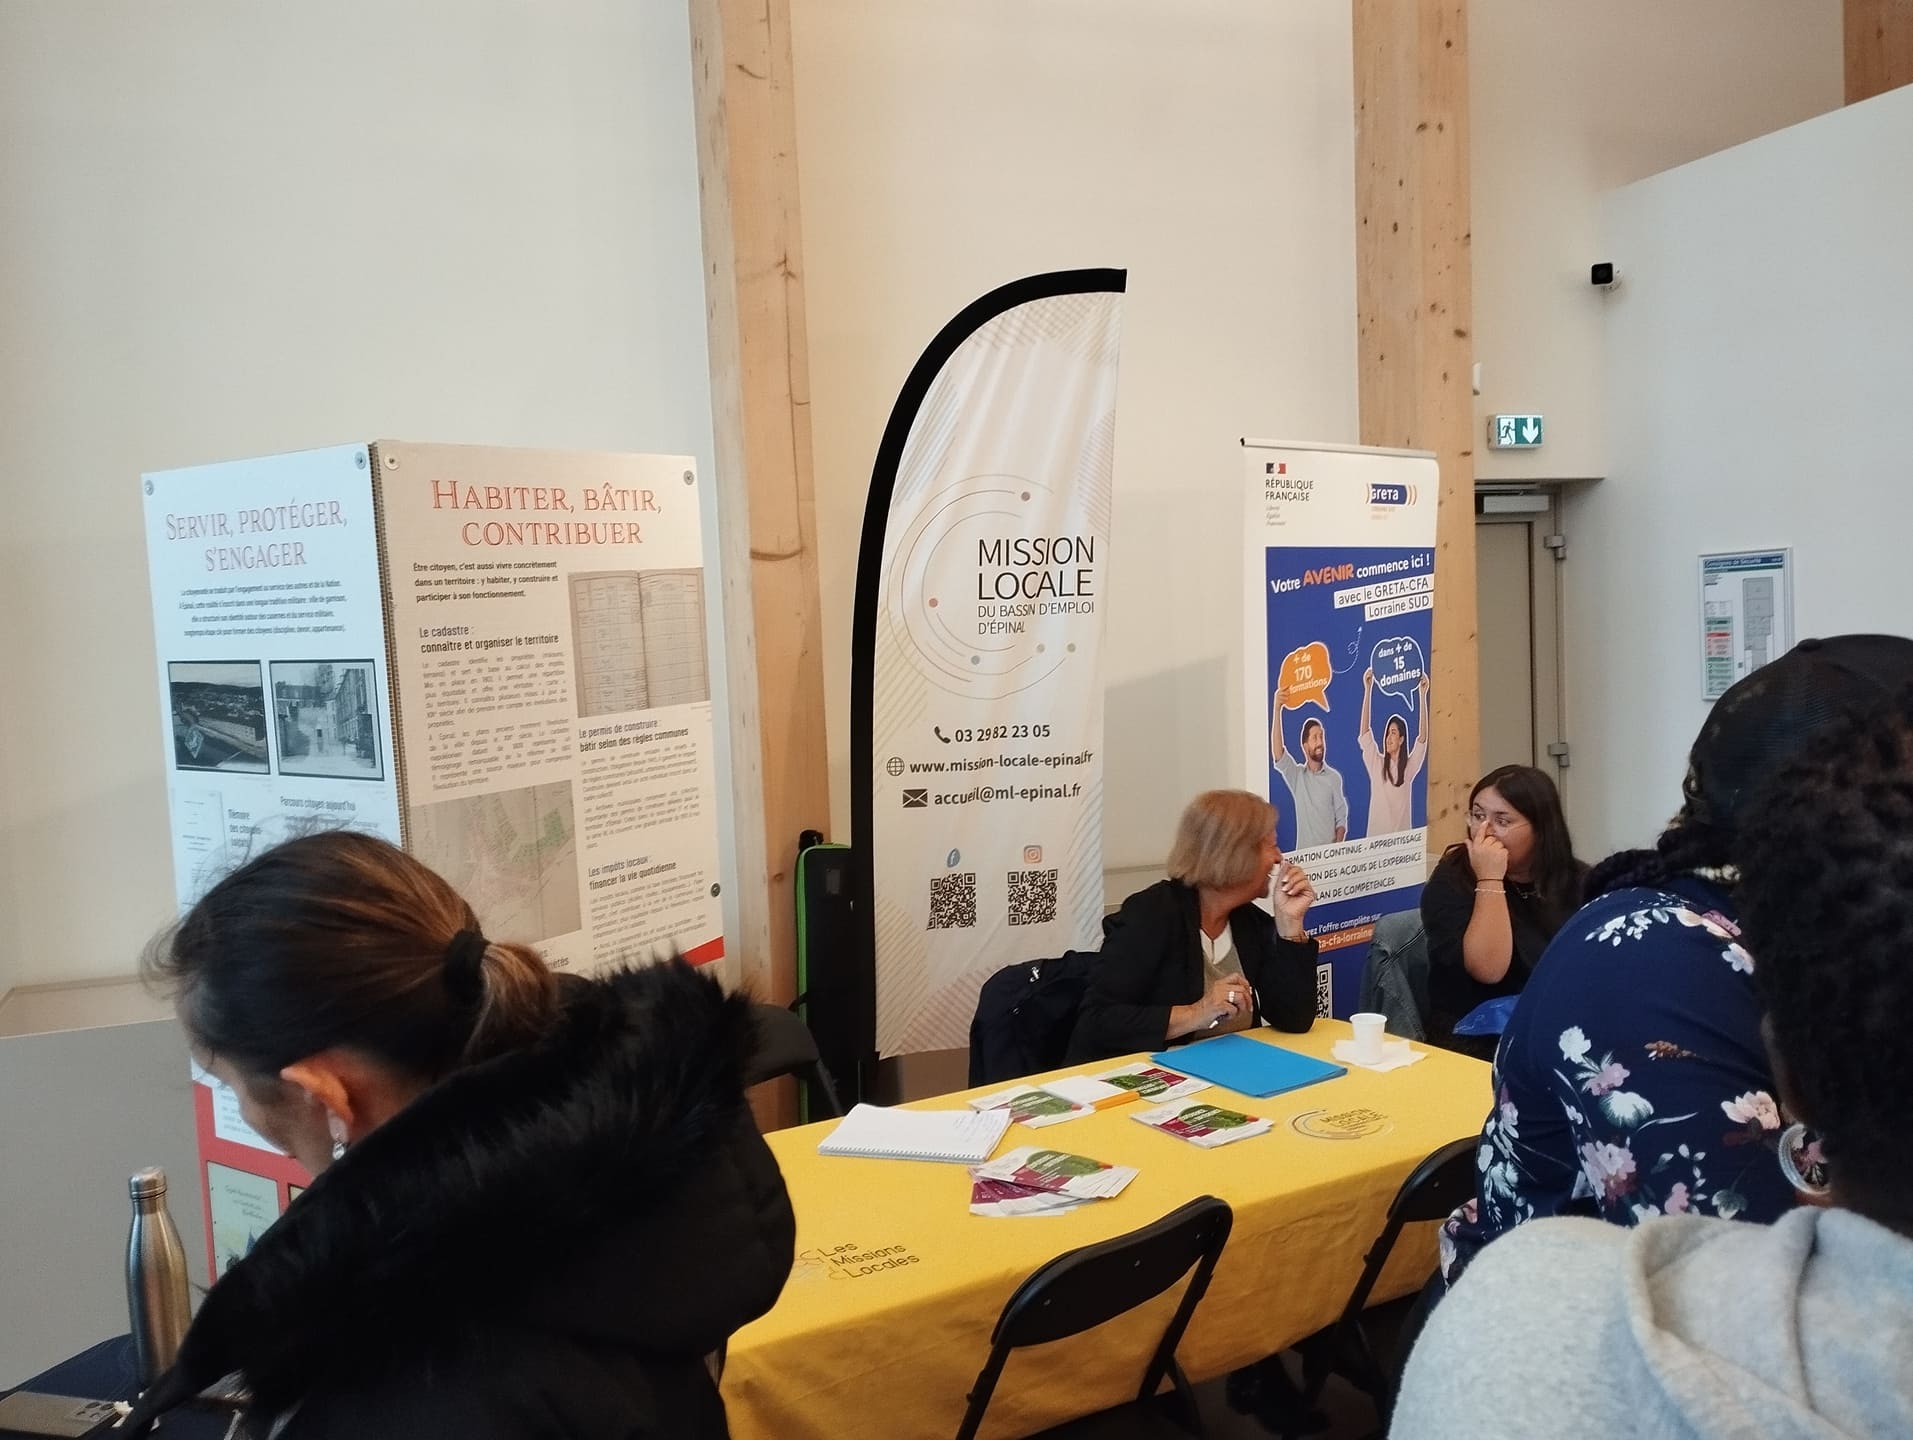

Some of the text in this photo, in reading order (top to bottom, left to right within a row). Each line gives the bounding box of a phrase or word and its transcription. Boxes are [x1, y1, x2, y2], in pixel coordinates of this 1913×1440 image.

[1265, 478, 1314, 491] RÉPUBLIQUE
[582, 482, 662, 513] BÂTIR,
[1265, 490, 1310, 502] FRANÇAISE
[238, 498, 348, 535] PROTÉGER,
[461, 520, 644, 547] CONTRIBUER
[977, 536, 1095, 567] MISSION
[434, 577, 444, 586] un
[444, 574, 476, 586] territoire
[1270, 577, 1302, 594] Votre
[1302, 563, 1355, 587] AVENIR
[1356, 560, 1409, 579] commence
[1410, 555, 1425, 569] ici
[977, 569, 1094, 601] LOCALE
[1338, 576, 1430, 605] avec le GRETA-CFA
[458, 592, 472, 600] son
[977, 605, 996, 618] DU
[1038, 601, 1095, 616] D'EMPLOI
[1368, 595, 1430, 619] Lorraine SUD
[419, 627, 430, 638] Le
[431, 625, 469, 637] cadastre
[977, 618, 1026, 635] D'ÉPINAL
[464, 636, 474, 650] et
[475, 633, 514, 650] organiser
[515, 634, 523, 645] le
[524, 632, 560, 646] territoire
[1378, 647, 1394, 658] dans
[1403, 642, 1413, 652] de
[1301, 653, 1312, 662] de
[1393, 655, 1406, 670] 15
[1294, 665, 1313, 682] 170
[1380, 667, 1422, 687] domaines
[955, 729, 973, 743] 03
[1011, 725, 1029, 738] 23
[1032, 724, 1051, 738] 05
[934, 782, 1082, 805] accueil@ml-epinal.fr
[1324, 868, 1338, 879] DES
[1340, 863, 1367, 876] ACQUIS
[1368, 860, 1377, 870] DE
[1332, 888, 1342, 897] DE
[817, 1243, 859, 1257] Les
[830, 1244, 907, 1267] Missions
[842, 1254, 921, 1279] Locales
